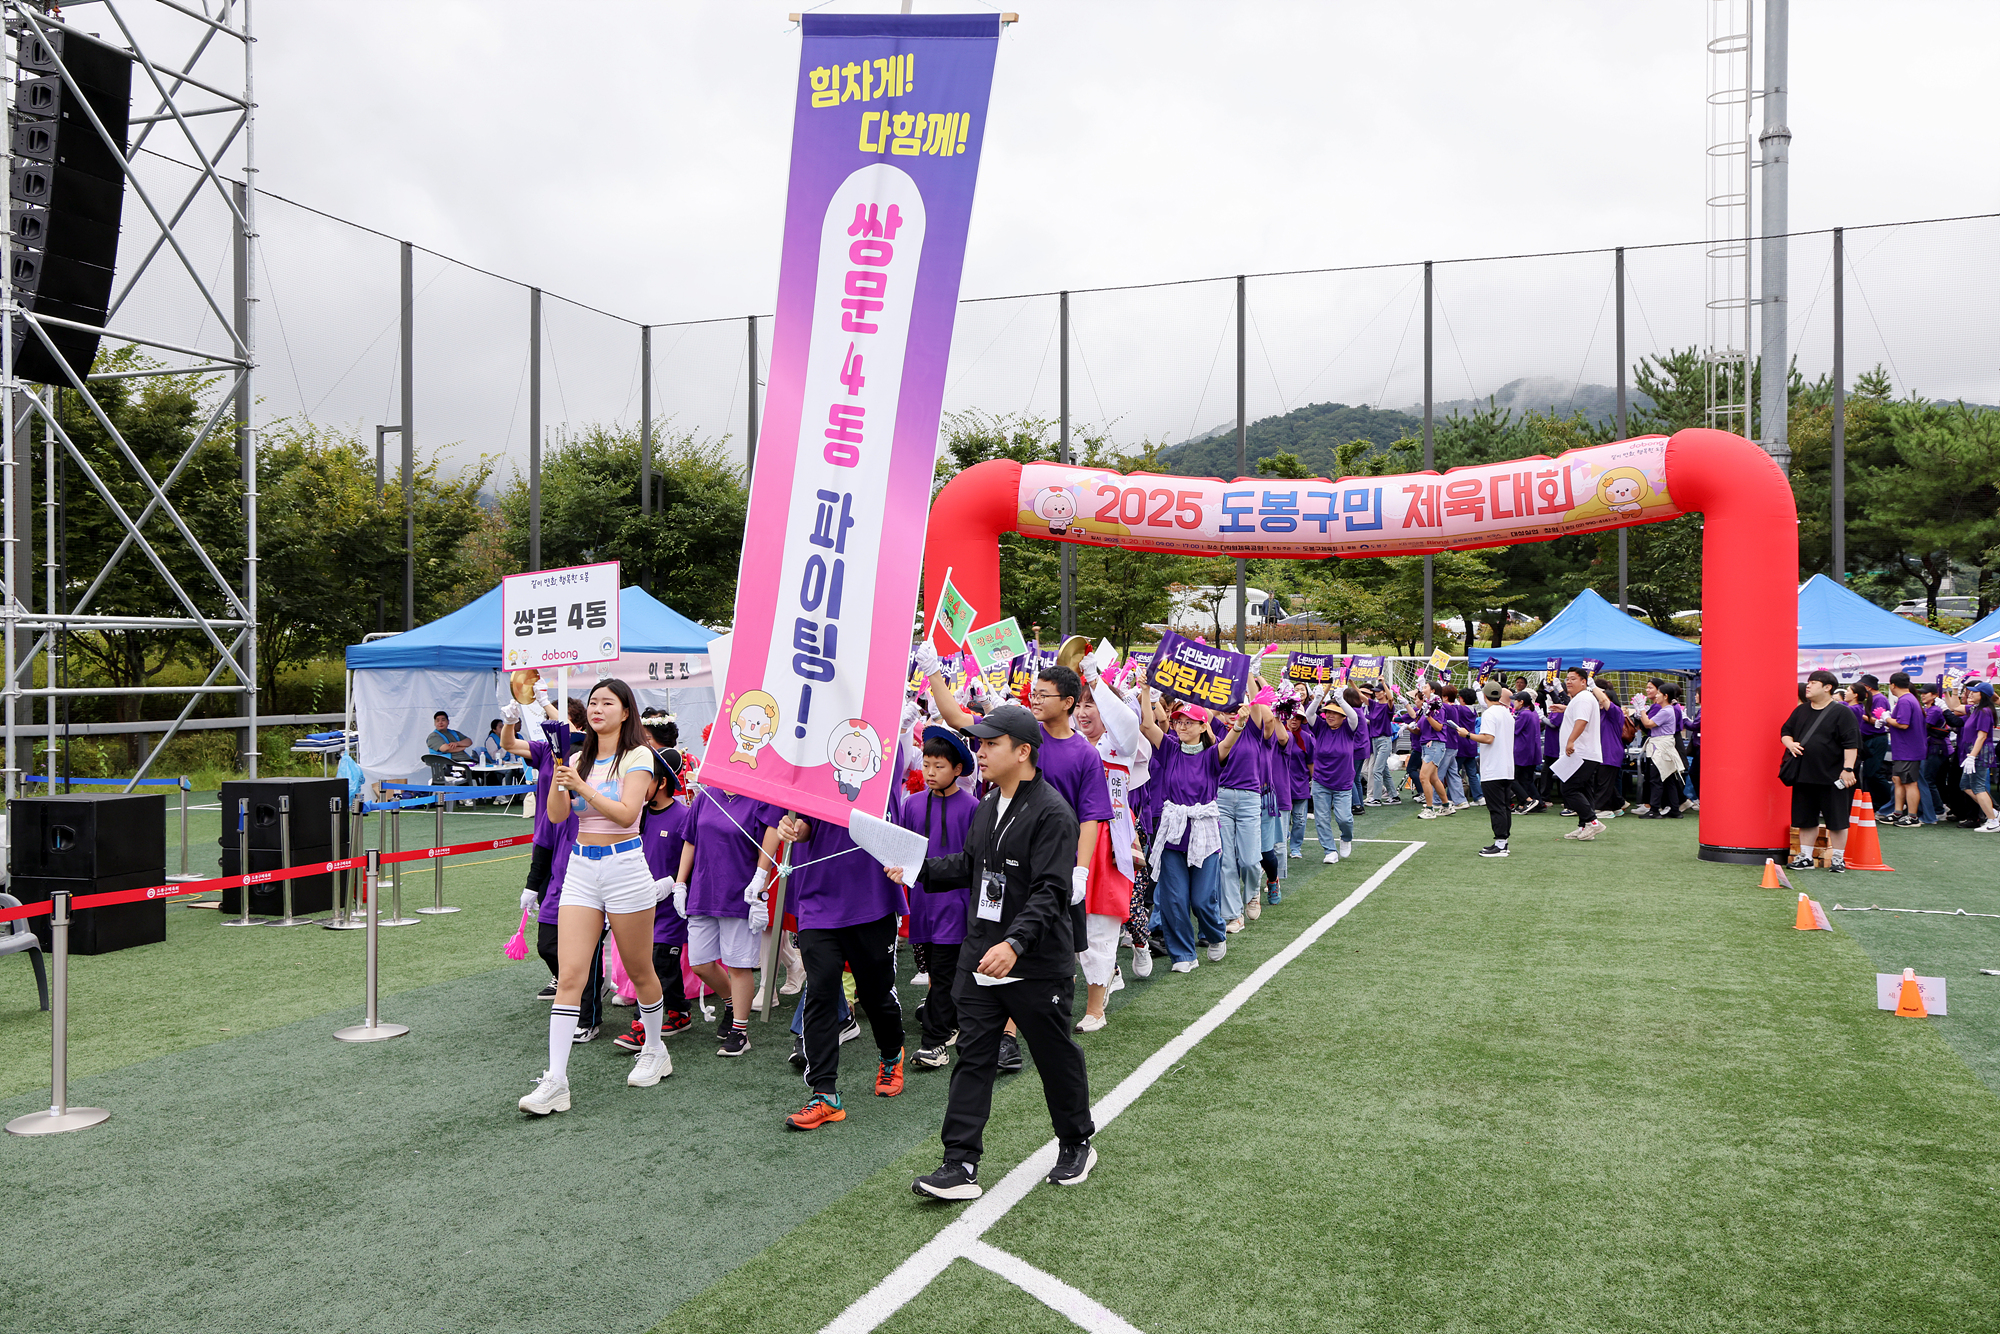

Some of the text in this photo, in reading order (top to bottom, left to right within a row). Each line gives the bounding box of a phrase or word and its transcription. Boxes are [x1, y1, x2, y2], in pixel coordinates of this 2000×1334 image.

[809, 53, 914, 108] 힘차게!
[858, 110, 971, 157] 다함께!
[1629, 440, 1664, 450] dobong
[1095, 465, 1576, 533] 2025 도봉구민 체육대회
[559, 573, 578, 585] 행복한
[580, 571, 590, 583] 도봉
[513, 600, 607, 637] 쌍문 4동
[792, 489, 855, 739] 파이팅!
[541, 649, 579, 661] dobong
[648, 662, 690, 681] 의료진
[1174, 643, 1226, 674] 너만보여!
[1155, 659, 1233, 706] 쌍문4동
[980, 899, 1002, 910] STAFF
